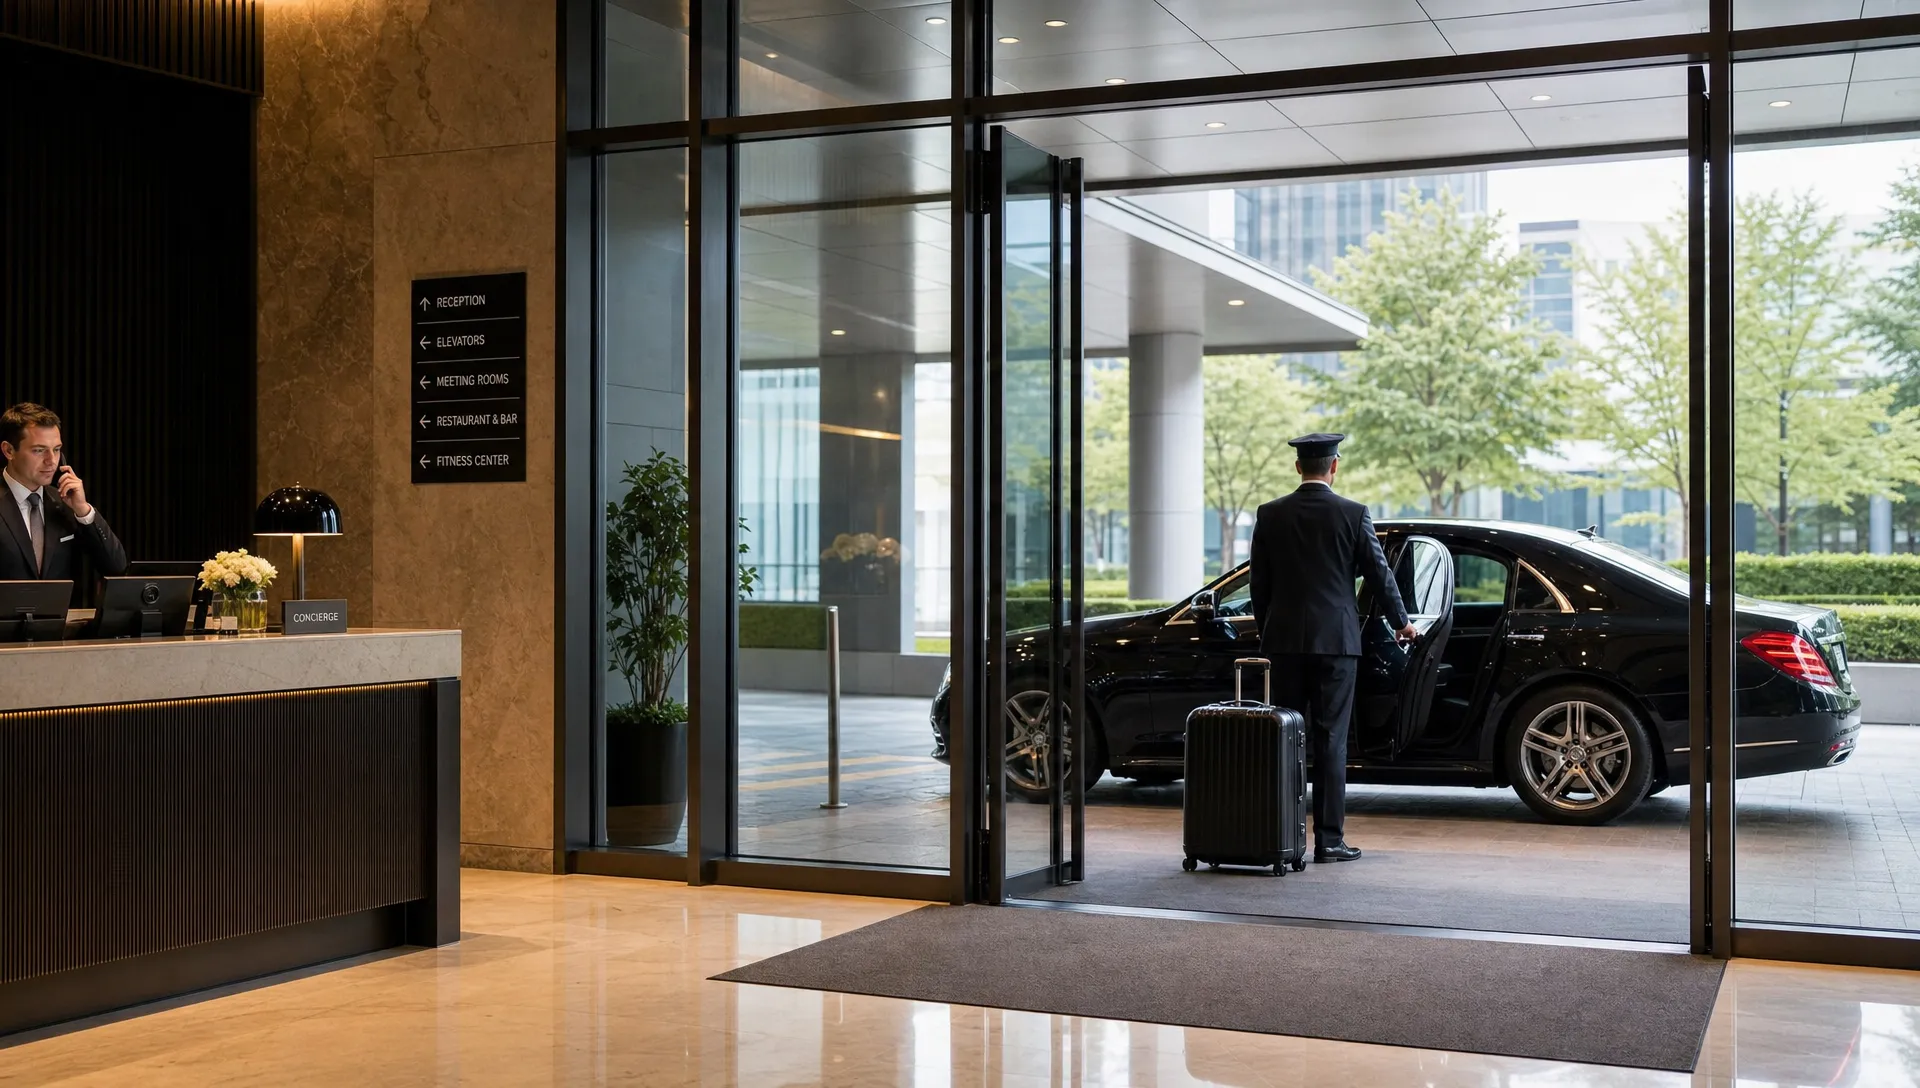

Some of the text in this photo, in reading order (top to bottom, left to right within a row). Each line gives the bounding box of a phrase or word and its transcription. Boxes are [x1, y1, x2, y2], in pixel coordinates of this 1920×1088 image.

[436, 295, 486, 308] RECEPTION
[436, 335, 485, 347] ELEVATORS
[436, 373, 509, 387] MEETING ROOMS
[436, 413, 518, 427] RESTAURANT & BAR
[436, 454, 509, 467] FITNESS CENTER
[293, 612, 339, 623] CONCIERGE
